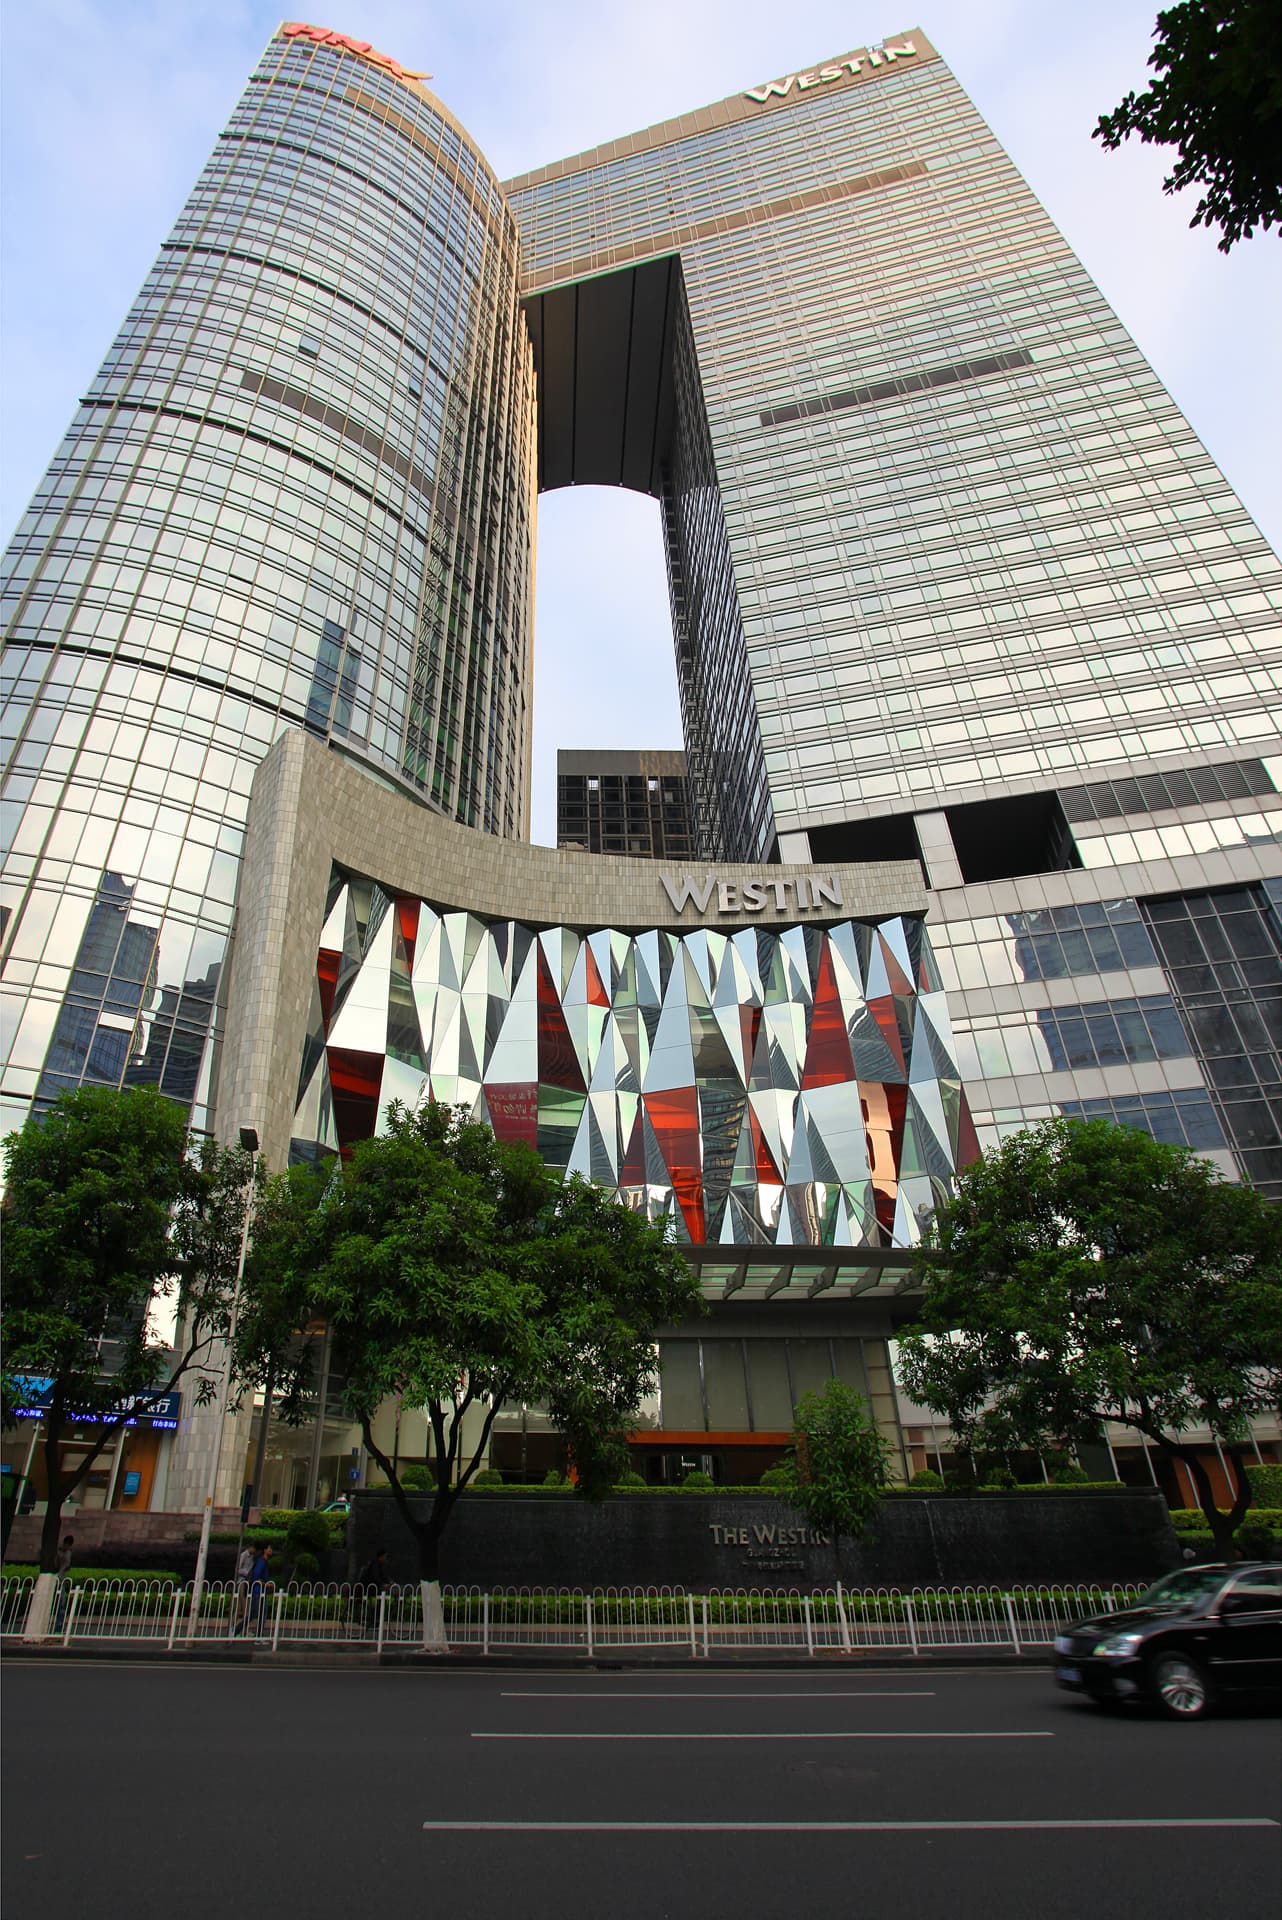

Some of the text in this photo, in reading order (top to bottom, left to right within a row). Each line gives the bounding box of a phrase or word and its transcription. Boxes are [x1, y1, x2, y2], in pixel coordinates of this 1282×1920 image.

[744, 40, 917, 103] WESTIN
[659, 874, 844, 913] WESTIN
[709, 1524, 750, 1546] THE
